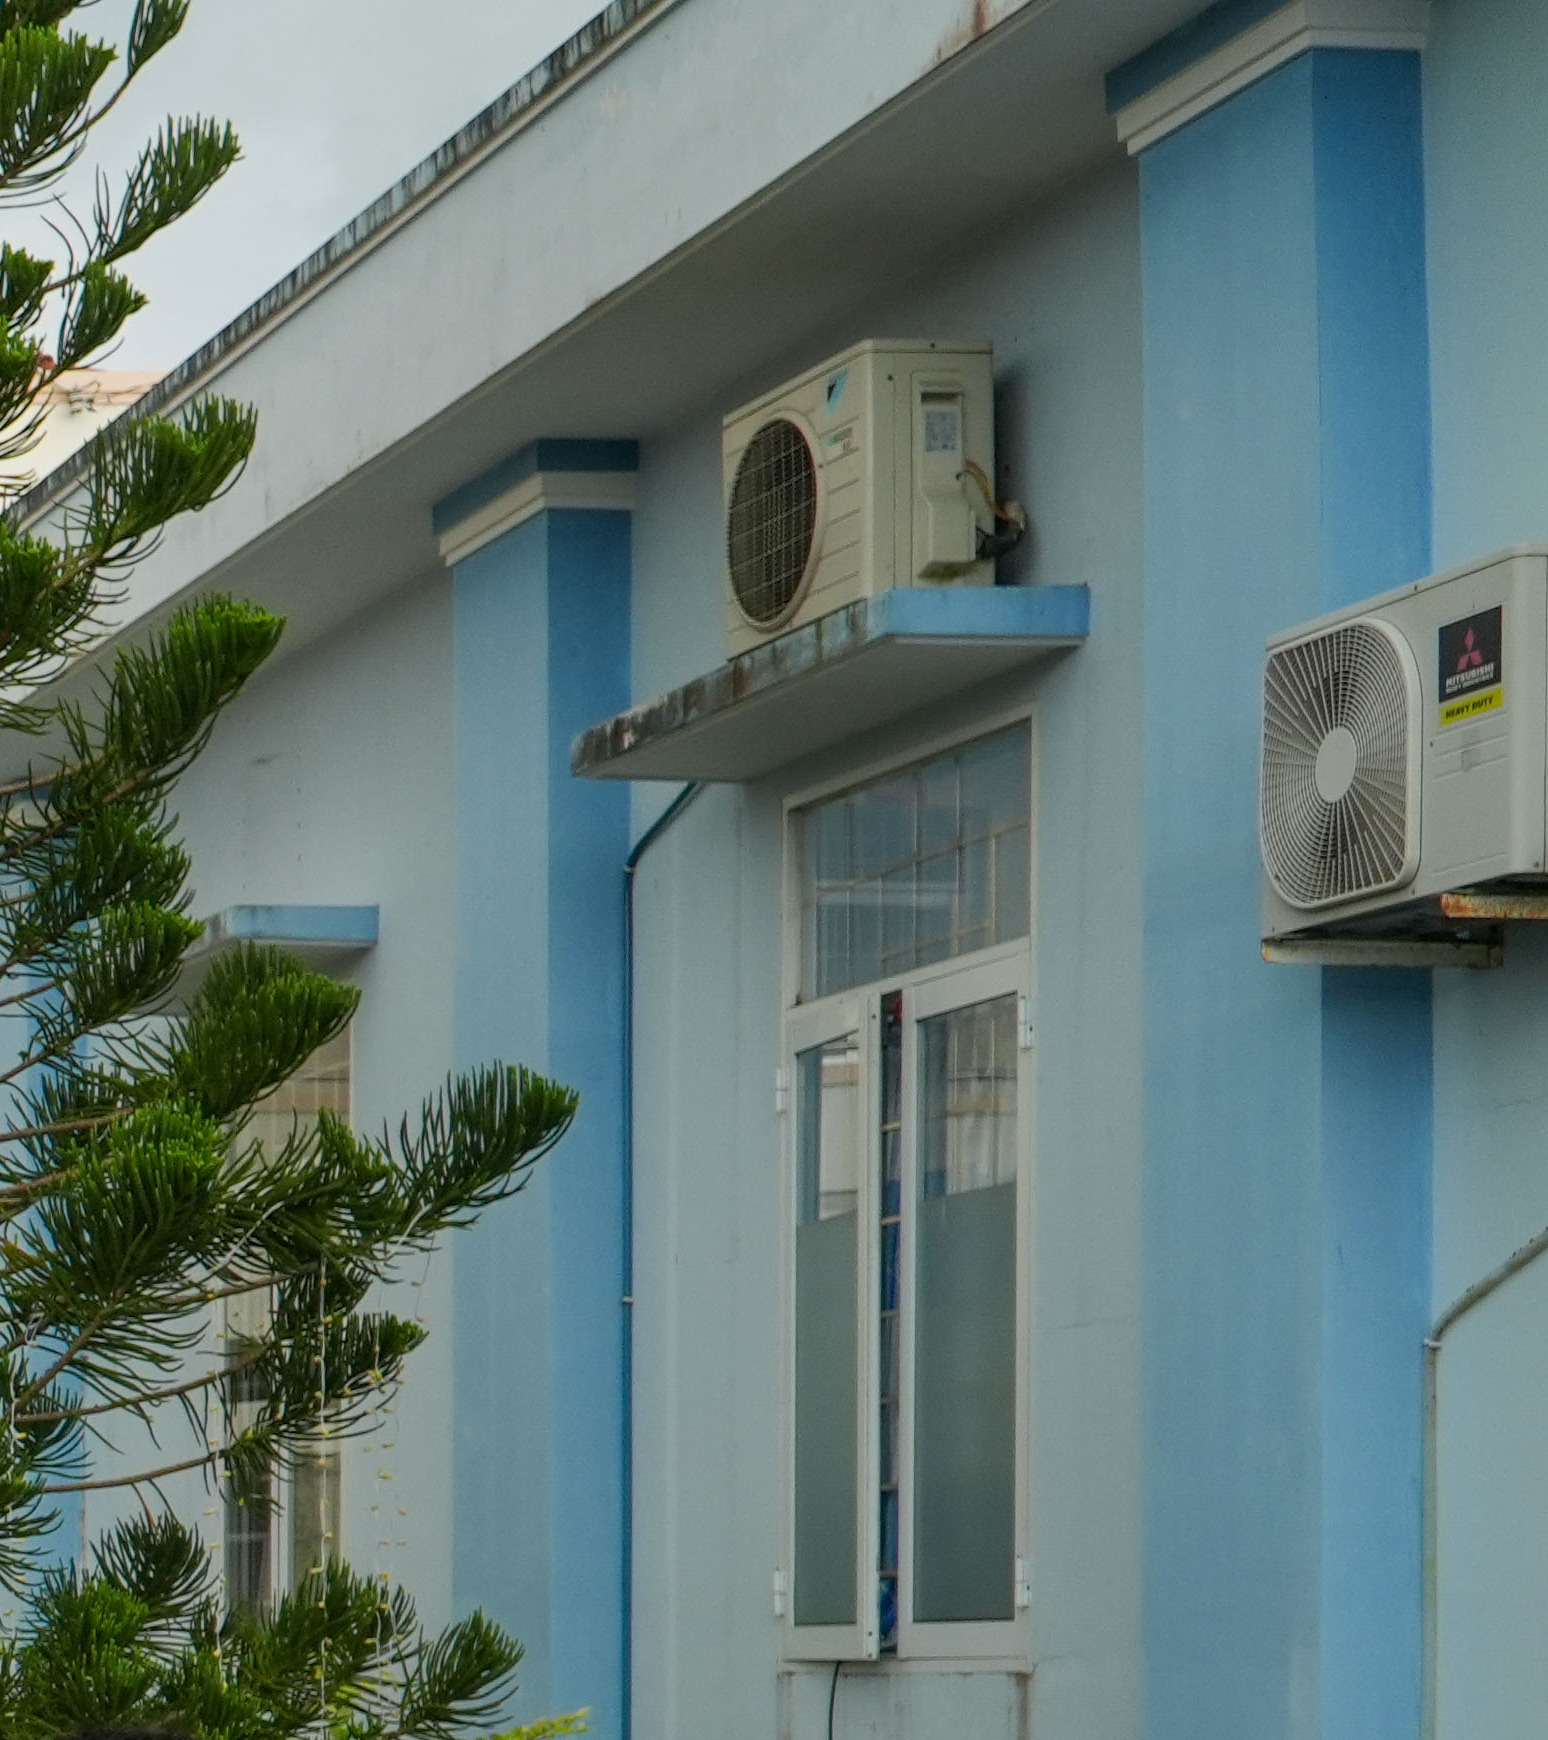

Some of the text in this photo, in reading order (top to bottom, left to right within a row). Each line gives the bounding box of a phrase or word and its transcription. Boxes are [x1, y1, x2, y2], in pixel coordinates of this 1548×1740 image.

[1446, 663, 1494, 689] MITSUBISHI
[1446, 695, 1494, 720] HEAVY DUTY
